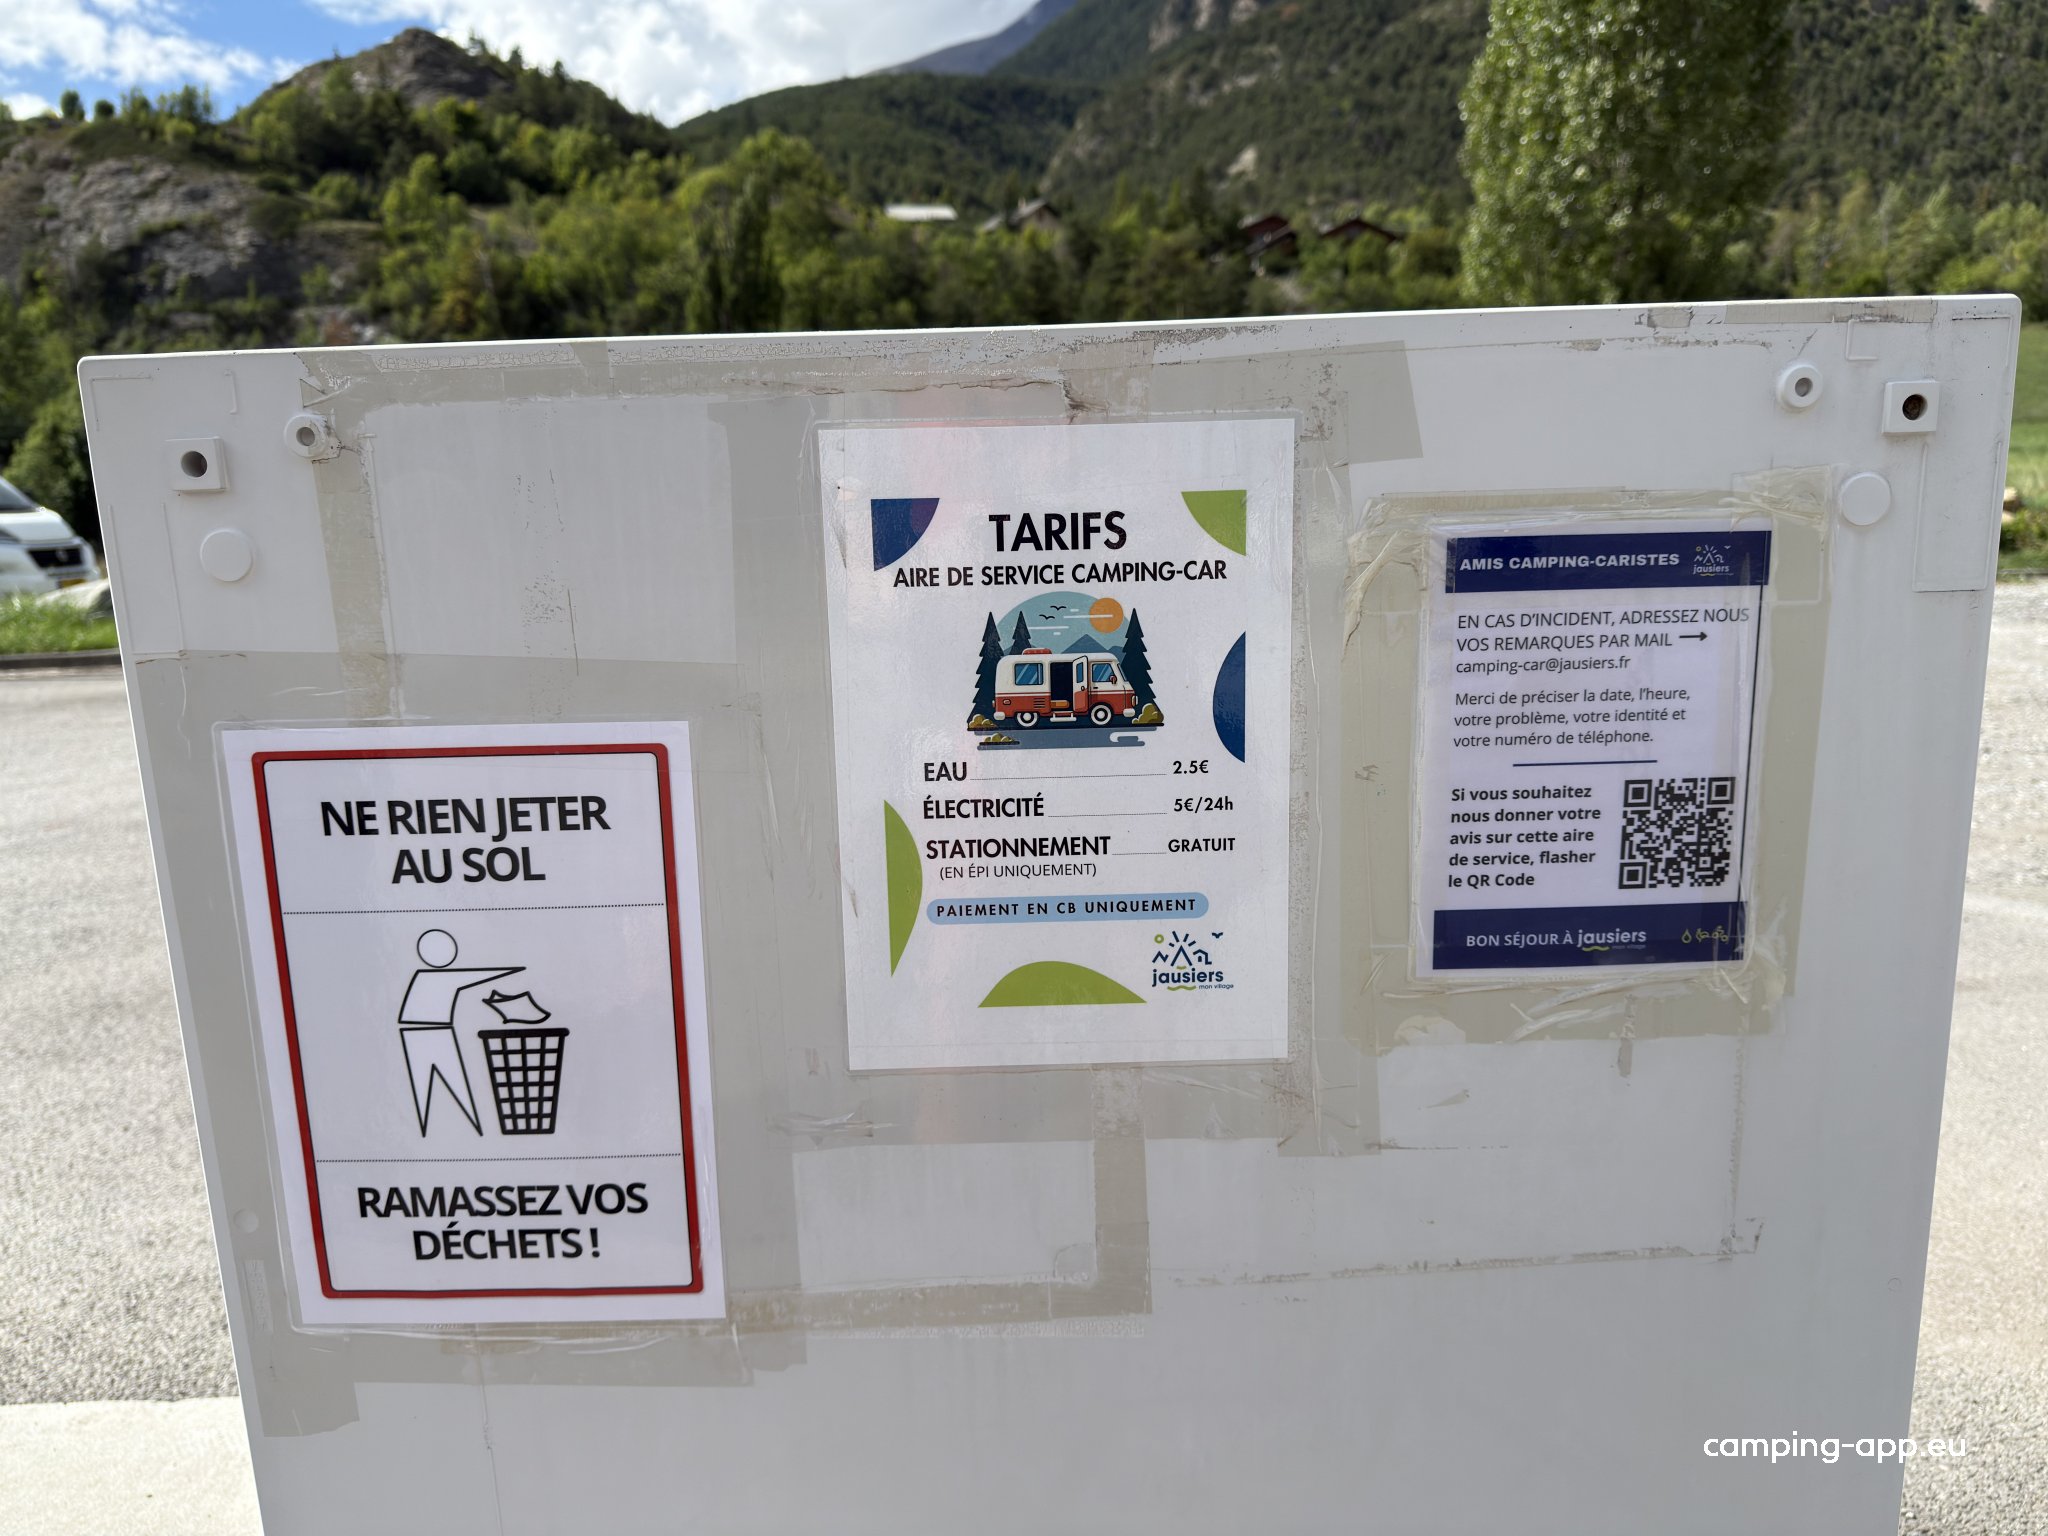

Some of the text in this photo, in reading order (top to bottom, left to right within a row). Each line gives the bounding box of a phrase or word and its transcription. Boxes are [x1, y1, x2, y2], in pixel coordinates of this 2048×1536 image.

[989, 511, 1126, 552] TARIFS
[1460, 554, 1679, 570] AMIS CAMPING-CARISTES
[1693, 564, 1729, 576] jausiers
[893, 560, 1227, 587] AIRE DE SERVICE CAMPING-CAR
[1459, 616, 1479, 628] EN
[1485, 614, 1515, 628] CAS
[1620, 610, 1699, 624] ADRESSEZ
[1704, 609, 1749, 622] NOUS
[1457, 633, 1672, 651] VOS REMARQUES PAR MAIL
[1456, 656, 1630, 675] camping-car@jausiers.fr
[1456, 693, 1494, 705] Merci
[1499, 692, 1517, 704] de
[1522, 690, 1579, 707] préciser
[1584, 689, 1595, 701] la
[1600, 689, 1634, 702] date,
[1454, 708, 1686, 728] votre problème, votre identité et
[1454, 730, 1653, 747] votre numéro de téléphone.
[924, 760, 1208, 781] EAU 2.5€
[1452, 786, 1591, 801] Si vous souhaitez
[924, 792, 1233, 819] ÉLECTRICITÉ 5€/24h
[321, 796, 611, 842] NE RIEN JETER
[1451, 808, 1601, 823] nous donner votre
[1450, 829, 1594, 844] avis sur cette aire
[927, 836, 1235, 859] STATIONNEMENT GRATUIT
[392, 847, 546, 884] AU SOL
[1449, 851, 1596, 866] de service, flasher
[940, 863, 1096, 880] (EN ÉPI UNIQUEMENT)
[1449, 873, 1534, 889] le QR Code
[937, 899, 1195, 916] PAIEMENT EN CB UNIQUEMENT
[1467, 935, 1499, 946] BON
[1504, 932, 1559, 948] SÉJOUR
[1563, 930, 1573, 944] À
[1577, 928, 1646, 947] jausiers
[1152, 968, 1223, 988] jausiers
[358, 1183, 648, 1217] RAMASSEZ VOS
[413, 1221, 600, 1260] DÉCHETS !
